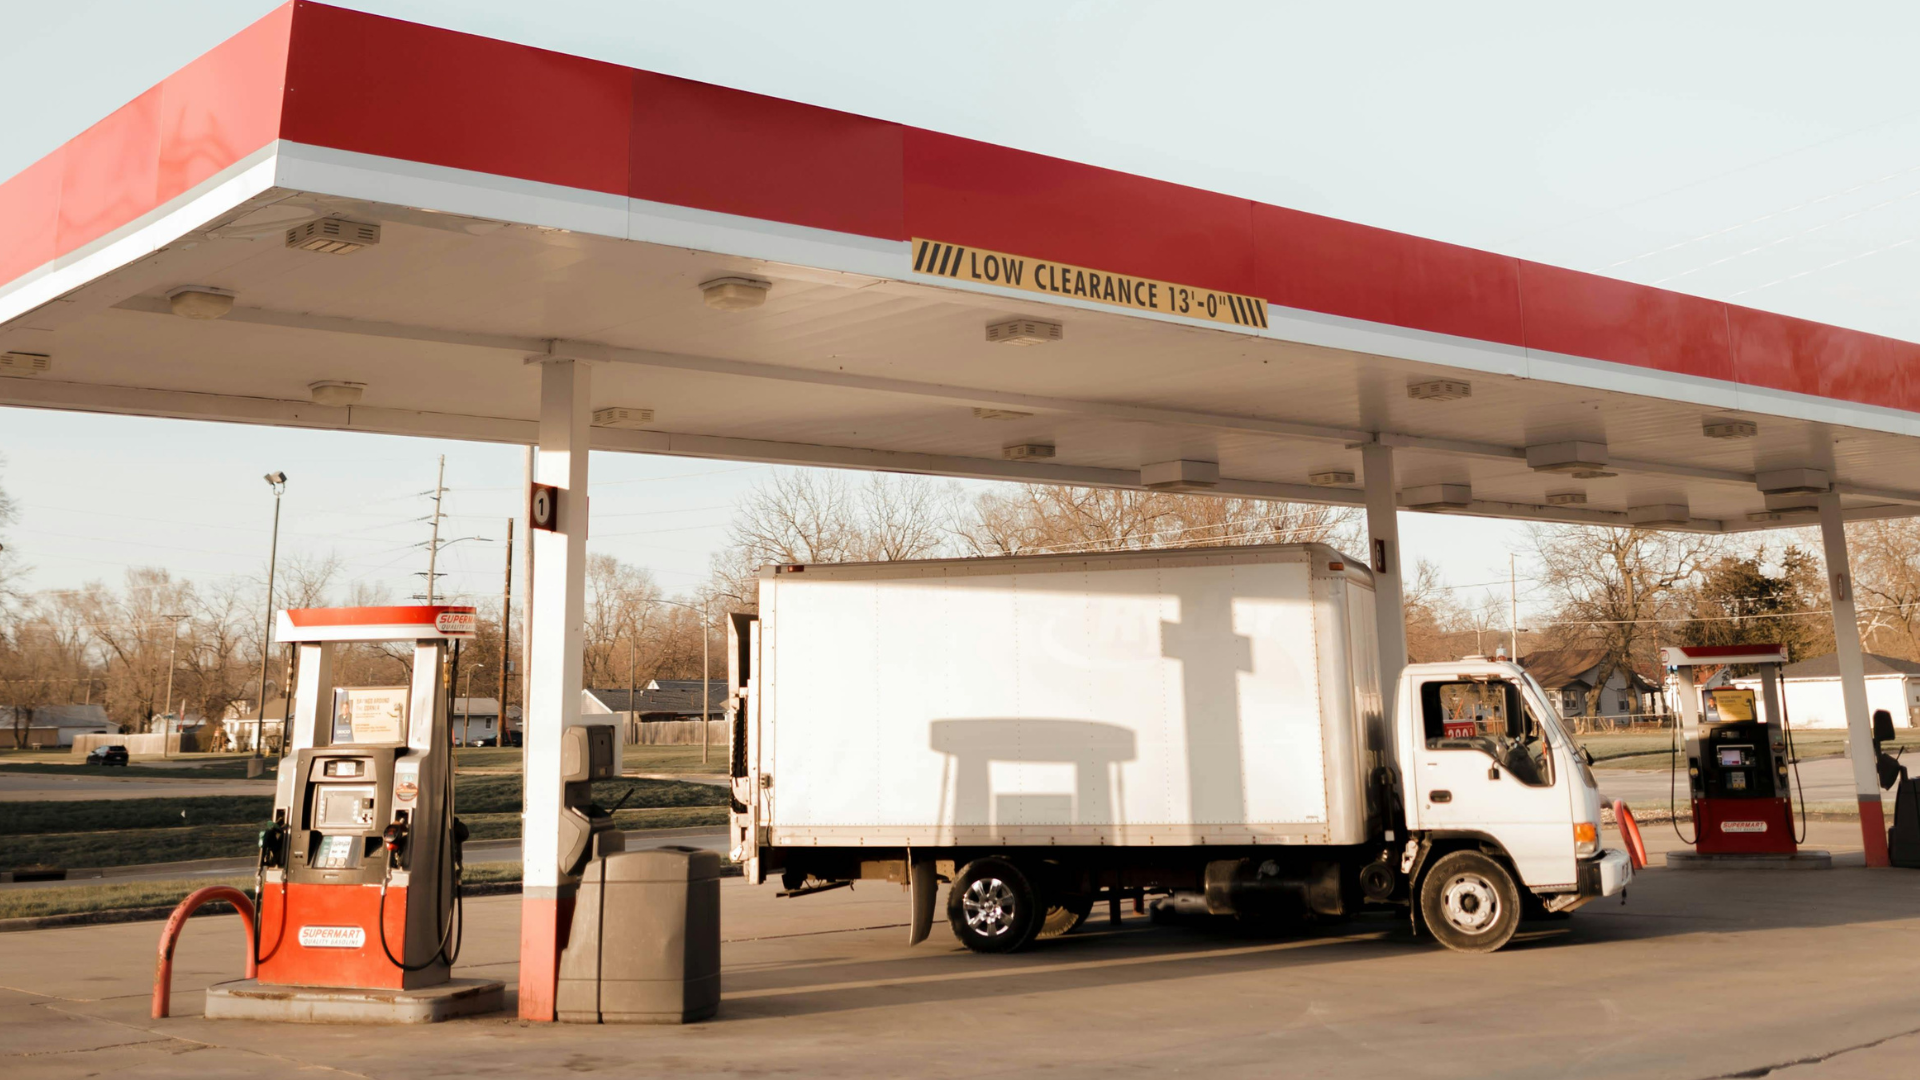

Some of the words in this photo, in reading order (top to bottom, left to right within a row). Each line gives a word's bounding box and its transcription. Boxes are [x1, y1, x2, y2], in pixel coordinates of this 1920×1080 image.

[971, 251, 1024, 286] LOW
[1034, 263, 1158, 309] CLEARANCE
[1168, 287, 1226, 318] 13'-0"
[538, 497, 544, 516] 1
[302, 928, 362, 939] SUPERMART
